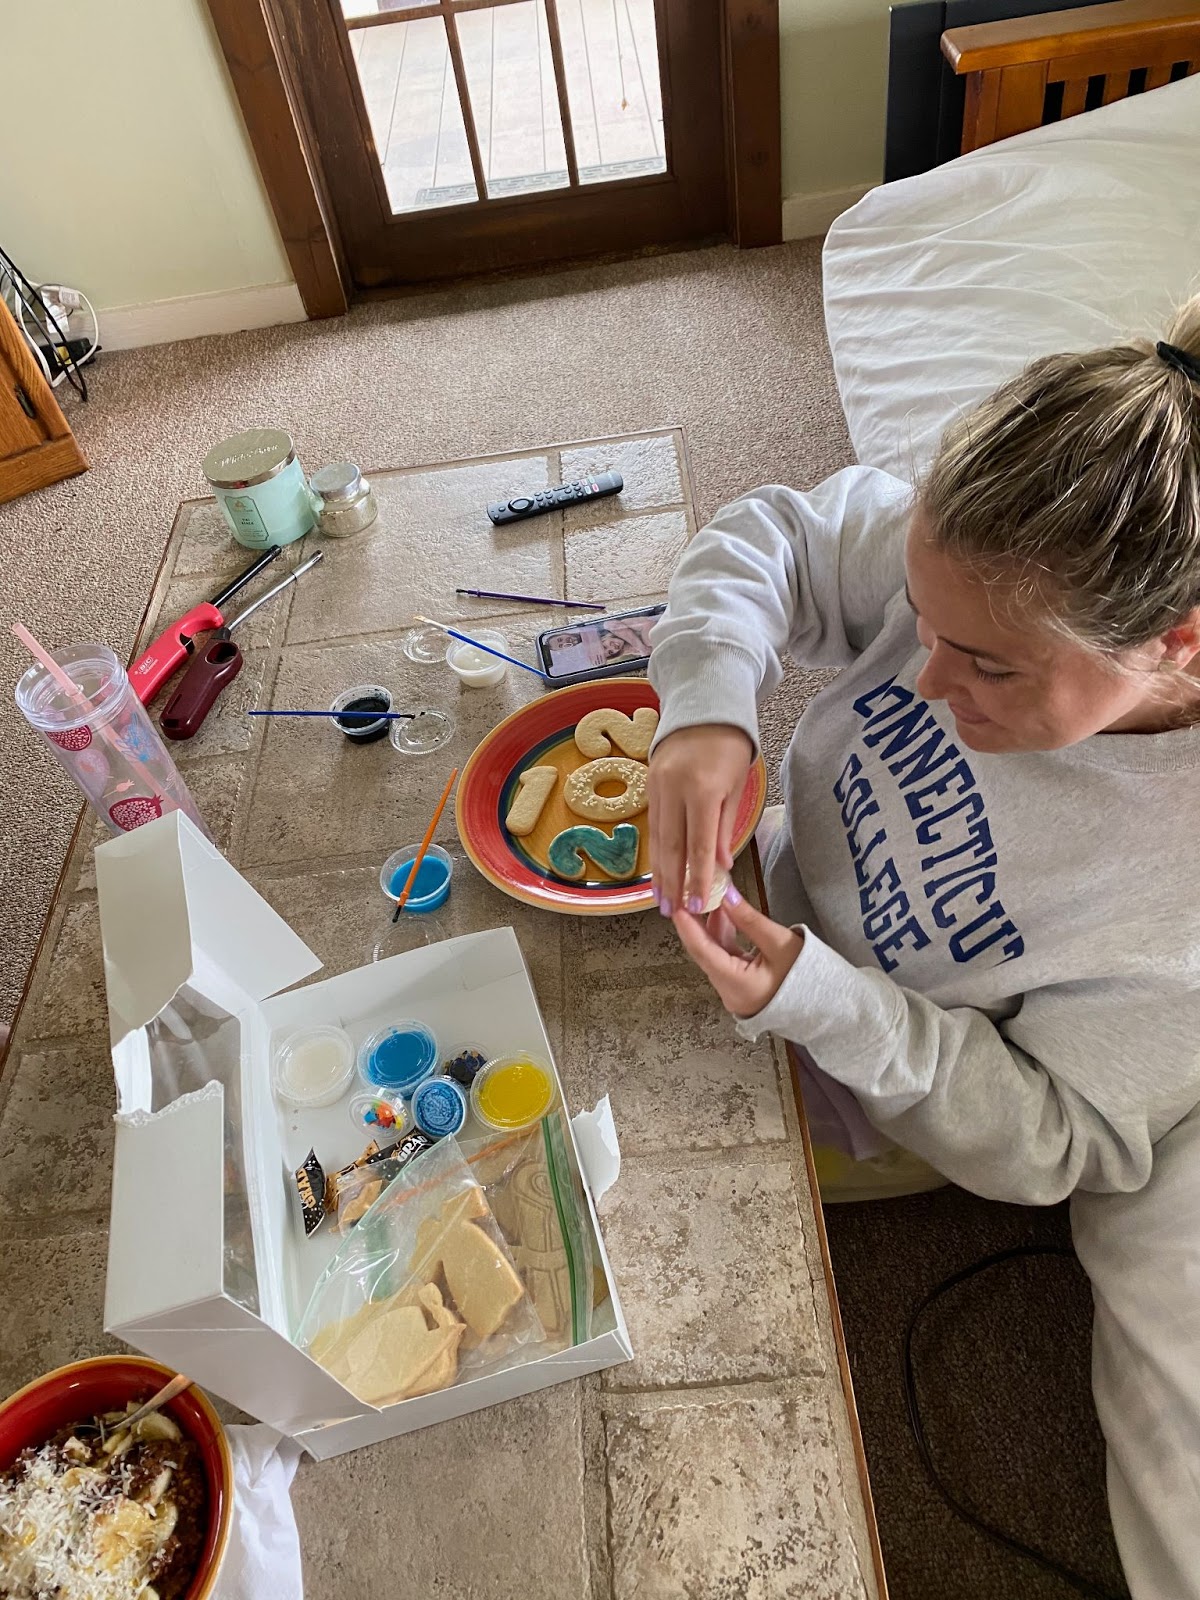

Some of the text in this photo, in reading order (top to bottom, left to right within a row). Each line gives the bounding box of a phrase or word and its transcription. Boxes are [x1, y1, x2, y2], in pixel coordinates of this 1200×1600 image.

[138, 656, 153, 672] BIC
[833, 753, 932, 973] COLLEGE
[397, 1135, 428, 1162] GRAD
[296, 1168, 317, 1209] GRAD
